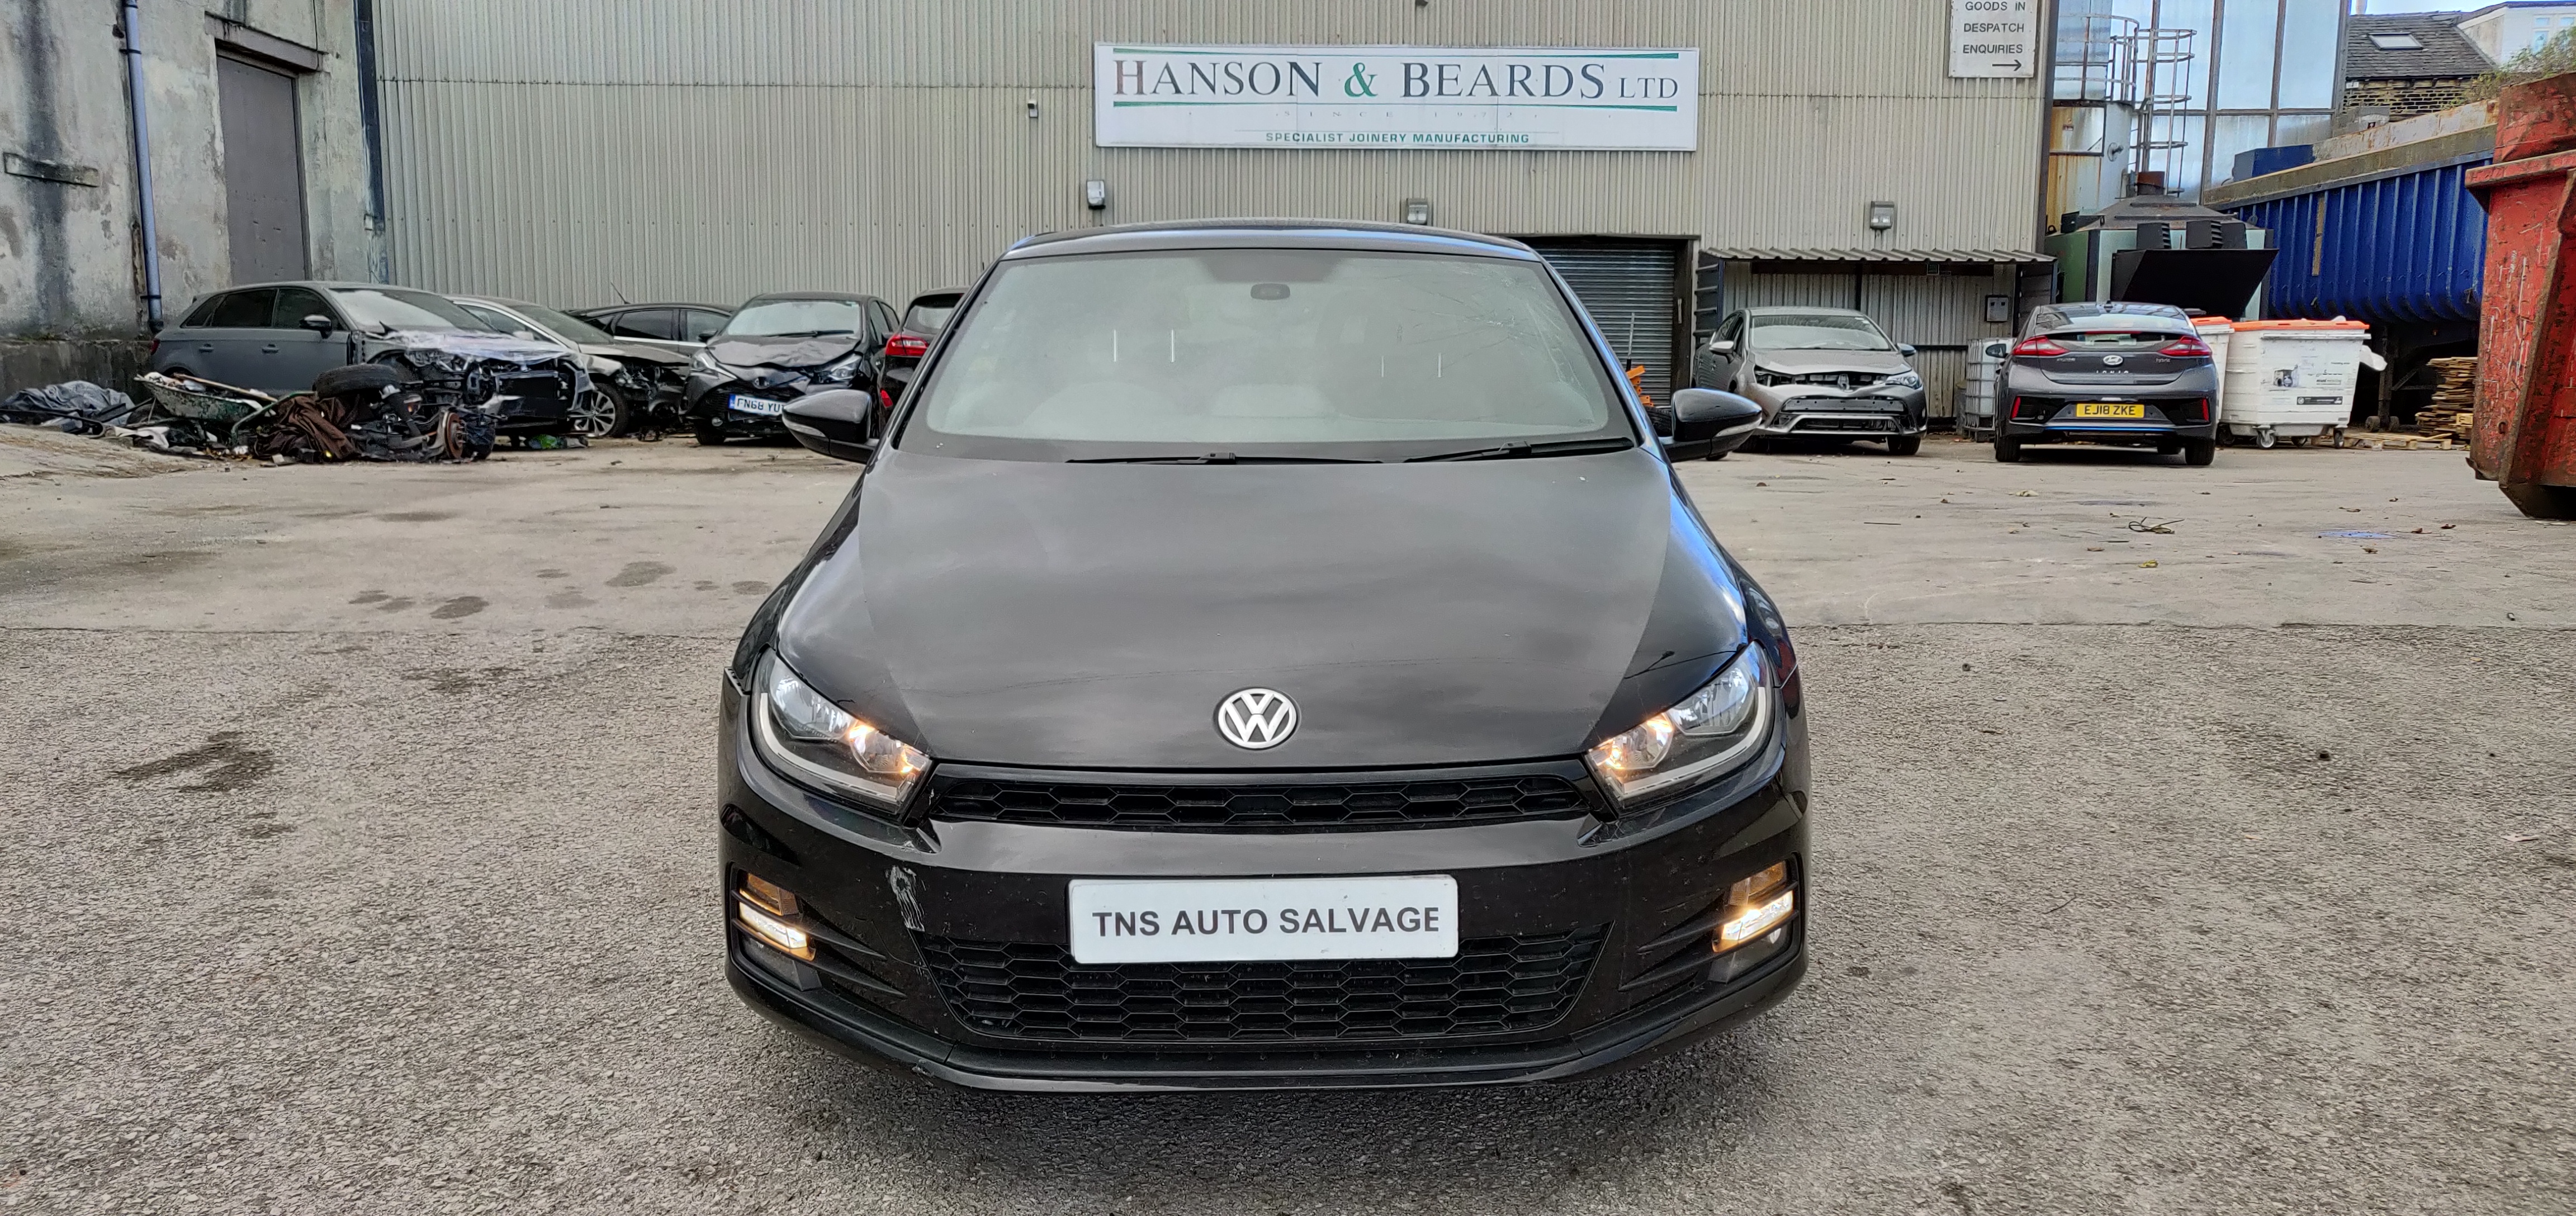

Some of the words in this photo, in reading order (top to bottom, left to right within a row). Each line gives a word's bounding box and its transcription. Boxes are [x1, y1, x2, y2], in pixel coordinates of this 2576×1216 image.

[1965, 1, 2007, 11] GOODS
[2015, 1, 2025, 11] IN
[1963, 23, 2024, 32] DESPATCH
[1963, 44, 2023, 54] ENQUIRIES
[1113, 60, 1323, 97] HANSON
[1344, 62, 1378, 98] &
[1400, 62, 1604, 99] BEARDS
[1619, 77, 1678, 99] LTD
[1266, 132, 1343, 143] SPECIALIST
[1349, 132, 1407, 144] JOINERY
[1412, 133, 1530, 144] MANUFACTURING
[737, 398, 764, 411] FN68
[768, 402, 784, 412] YU
[2084, 405, 2110, 415] EJ18
[2113, 405, 2136, 415] ZKE
[1092, 910, 1160, 937] TNS
[1171, 909, 1268, 935] AUTO
[1279, 906, 1439, 934] SALVAGE
